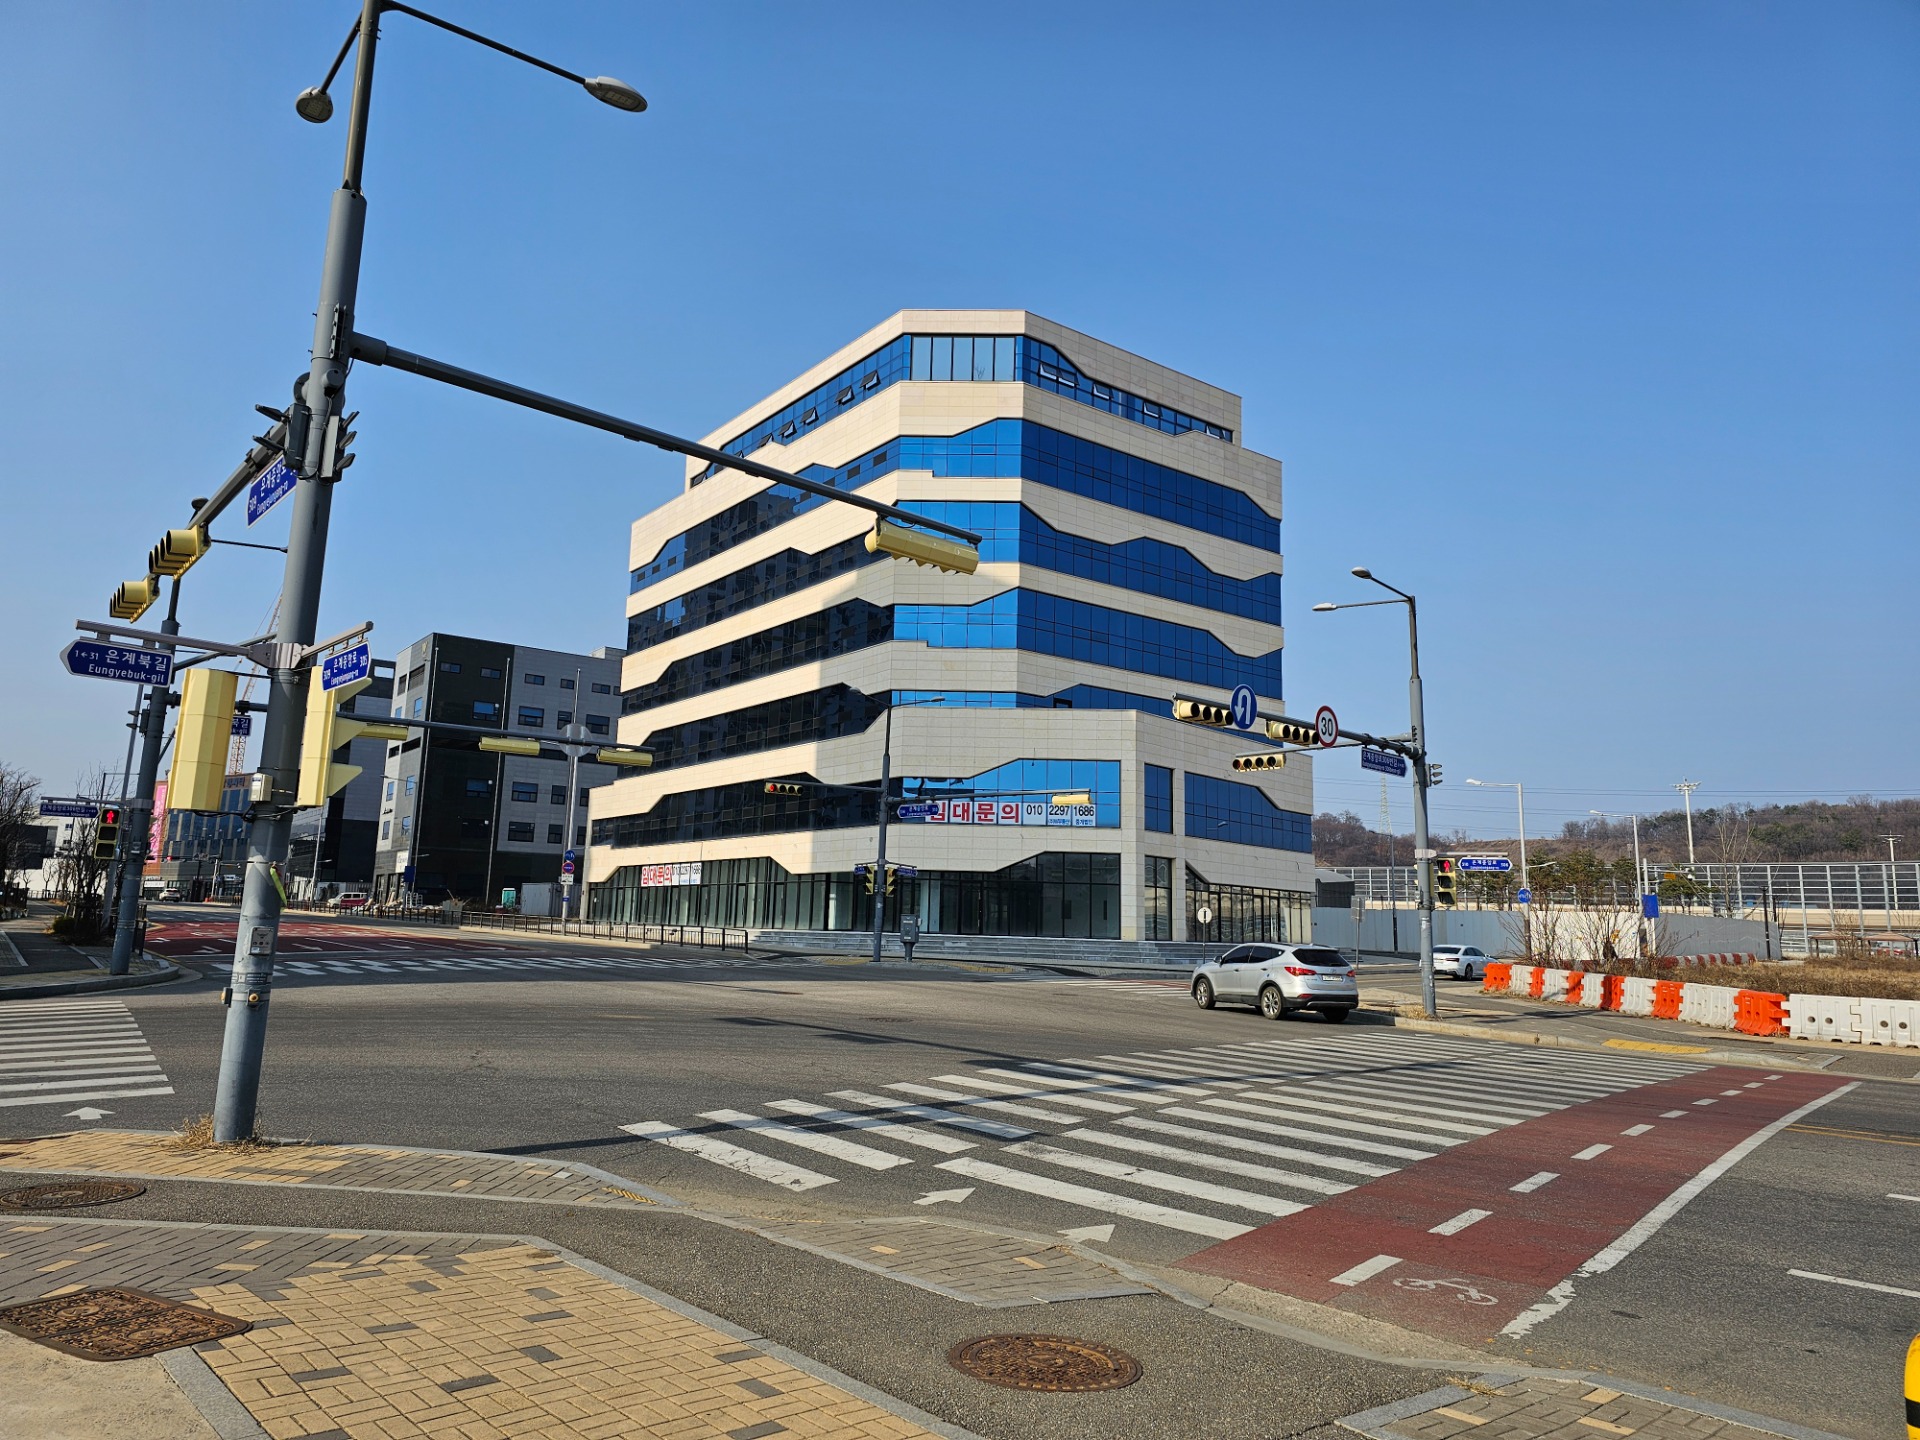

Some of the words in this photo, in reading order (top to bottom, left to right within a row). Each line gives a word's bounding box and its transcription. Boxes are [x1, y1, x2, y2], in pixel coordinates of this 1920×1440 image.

[105, 649, 167, 672] 은계북길
[88, 663, 165, 683] Eungyebuk-gil
[1321, 716, 1333, 737] 30
[1026, 805, 1043, 816] 010
[1049, 805, 1070, 816] 2297
[1074, 805, 1095, 817] 1686
[642, 866, 672, 885] 임대문의
